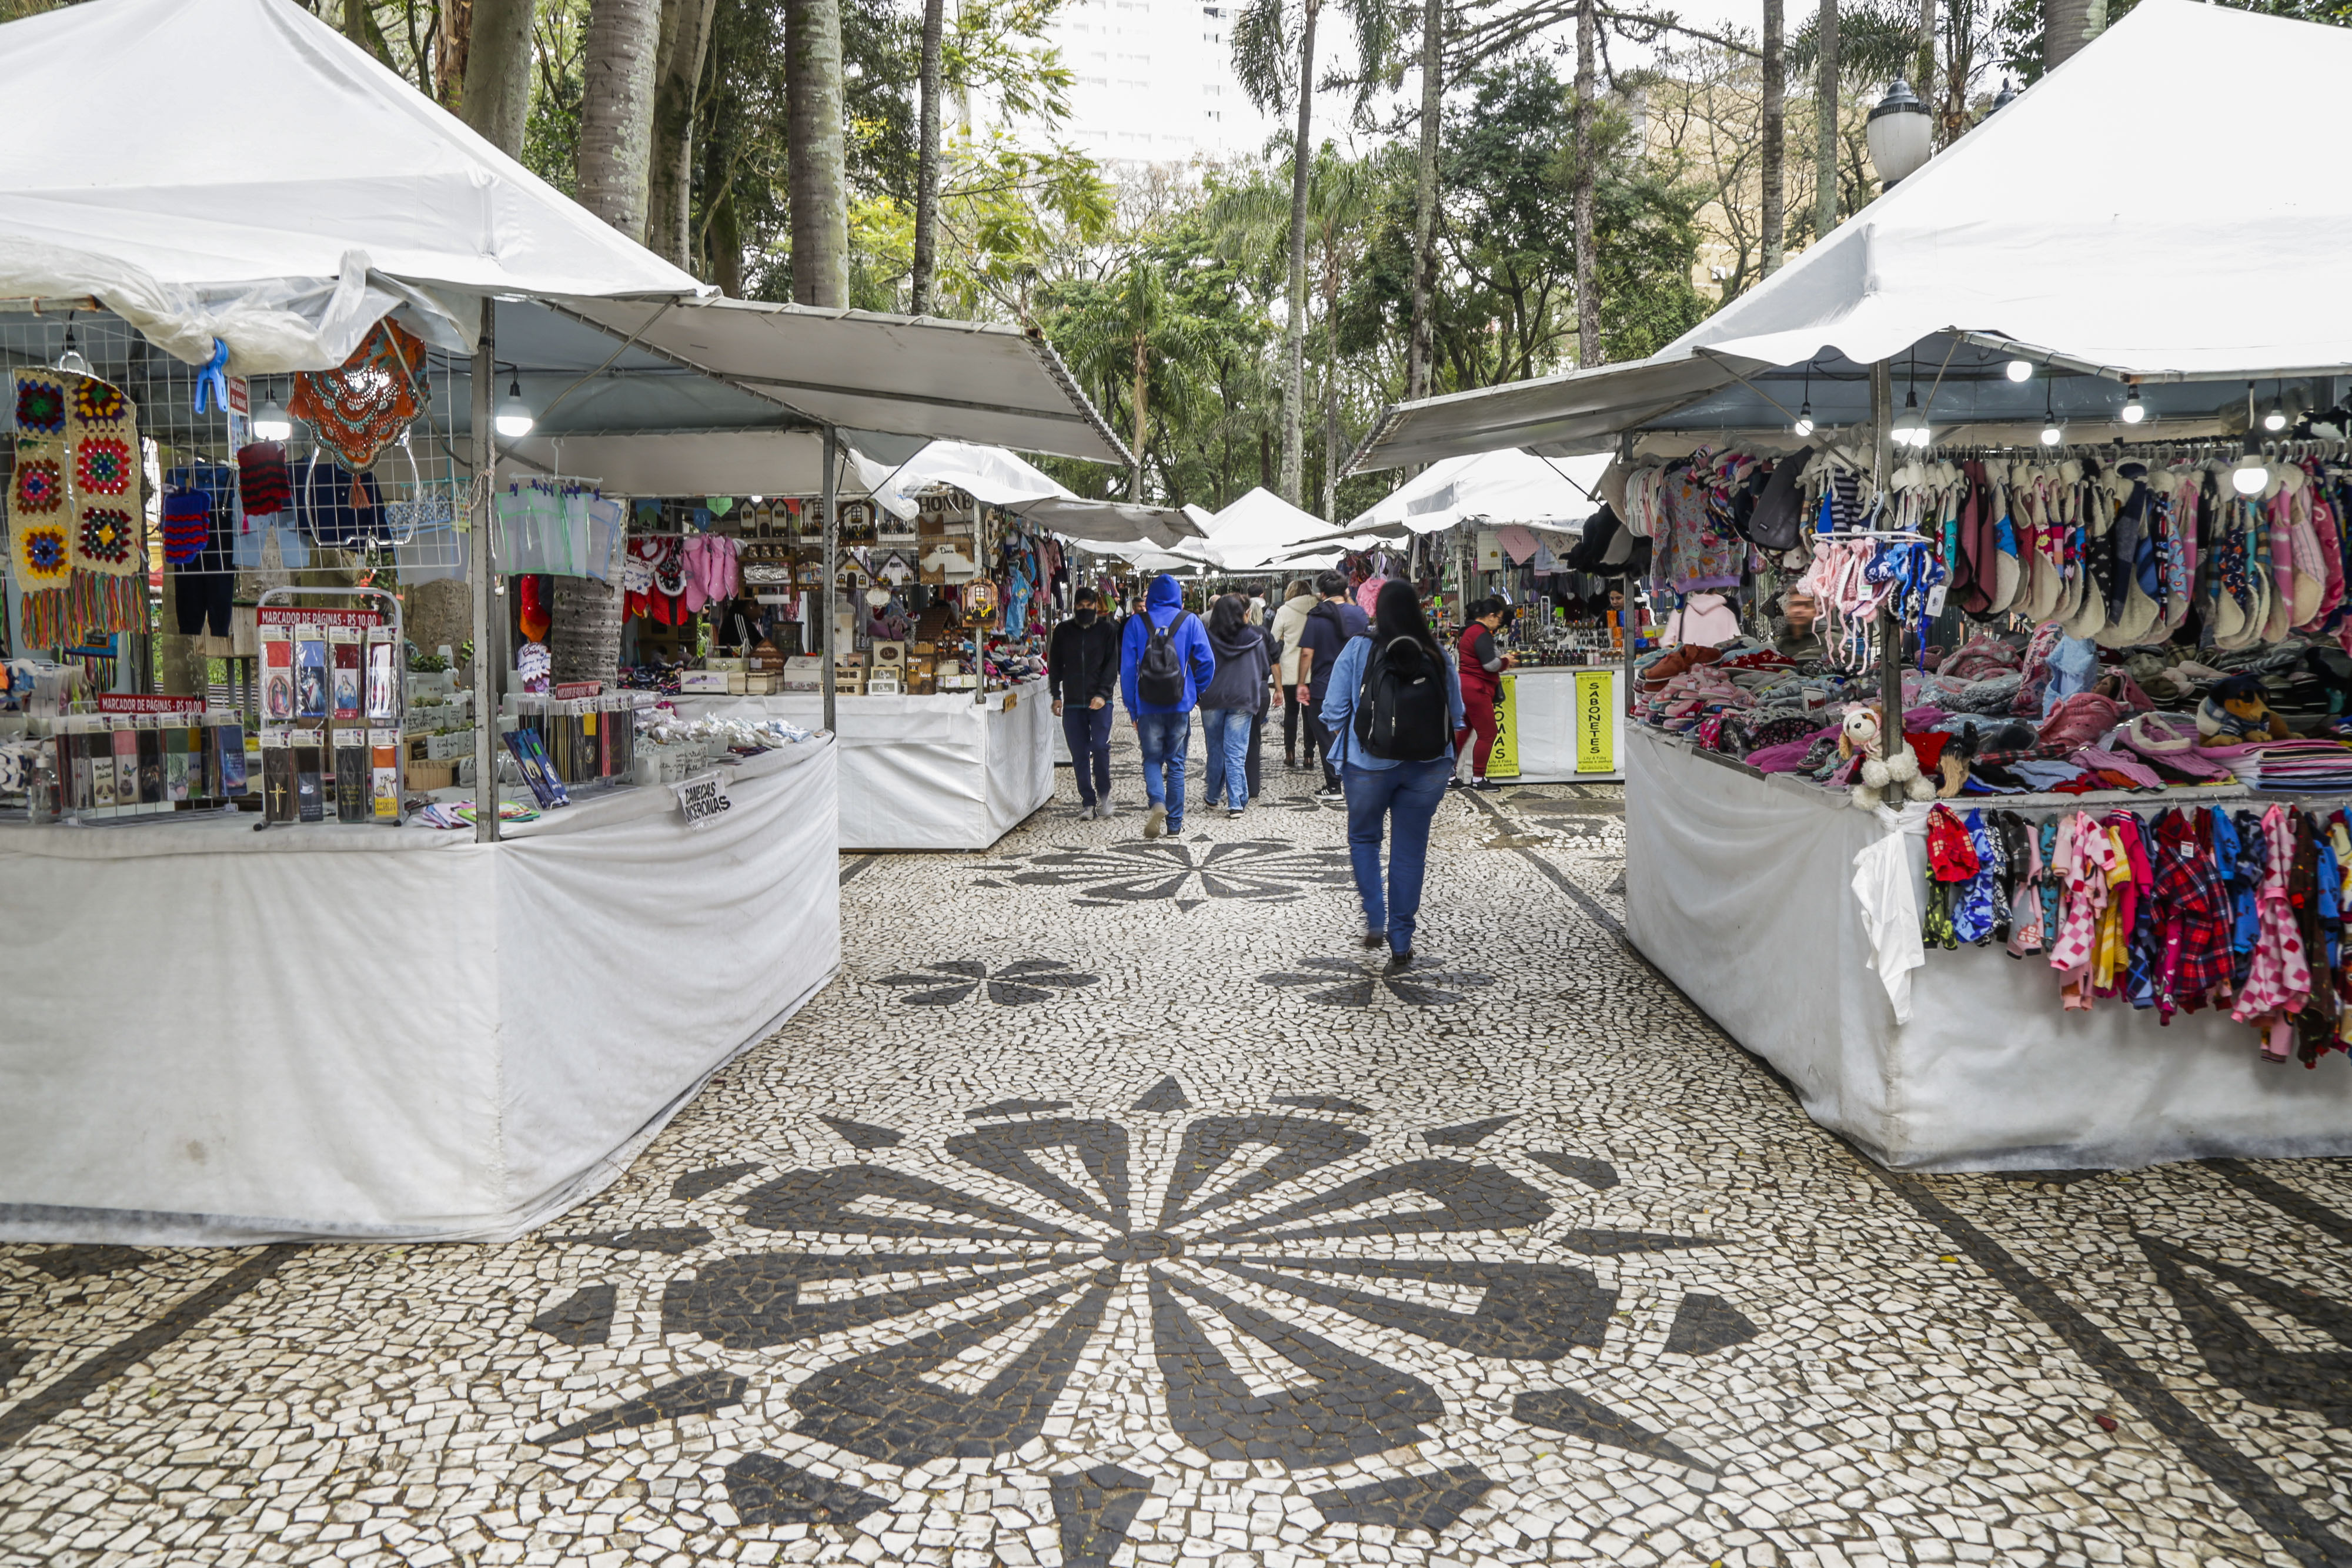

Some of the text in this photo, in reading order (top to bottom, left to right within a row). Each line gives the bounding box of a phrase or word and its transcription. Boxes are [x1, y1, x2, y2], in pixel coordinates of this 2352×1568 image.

[917, 493, 974, 513] HOME
[262, 611, 300, 624] MARCADOR
[302, 613, 311, 624] DE
[312, 610, 342, 626] PÁGINAS
[347, 614, 356, 626] R$
[358, 615, 377, 627] 10,00
[102, 698, 136, 711] MARCADOR
[137, 699, 145, 711] DE
[146, 697, 172, 712] PÁGINAS
[176, 700, 184, 712] R$
[1589, 683, 1601, 754] SABONETES
[685, 781, 716, 805] CANECAS
